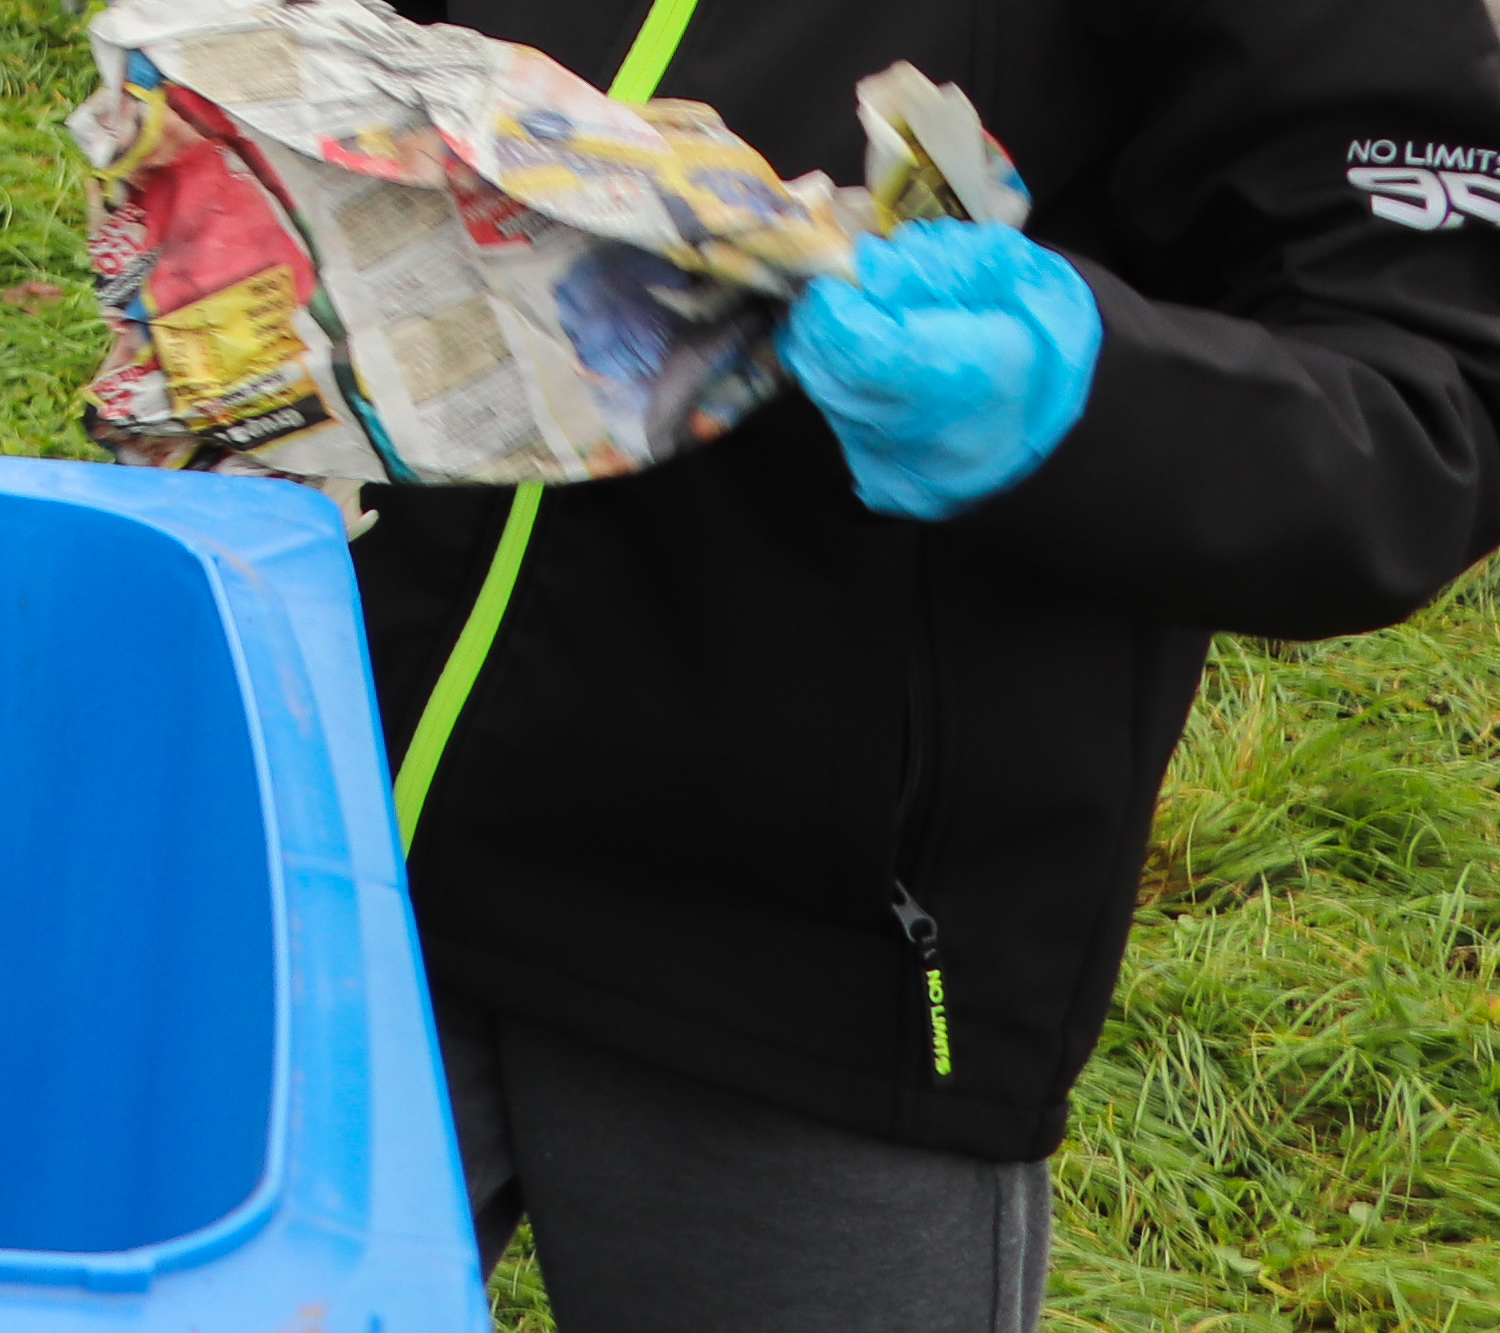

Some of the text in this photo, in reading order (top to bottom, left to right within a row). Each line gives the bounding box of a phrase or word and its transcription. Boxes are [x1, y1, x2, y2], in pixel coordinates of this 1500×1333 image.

[1347, 139, 1397, 165] NO
[926, 969, 952, 1076] NO LIMITS
